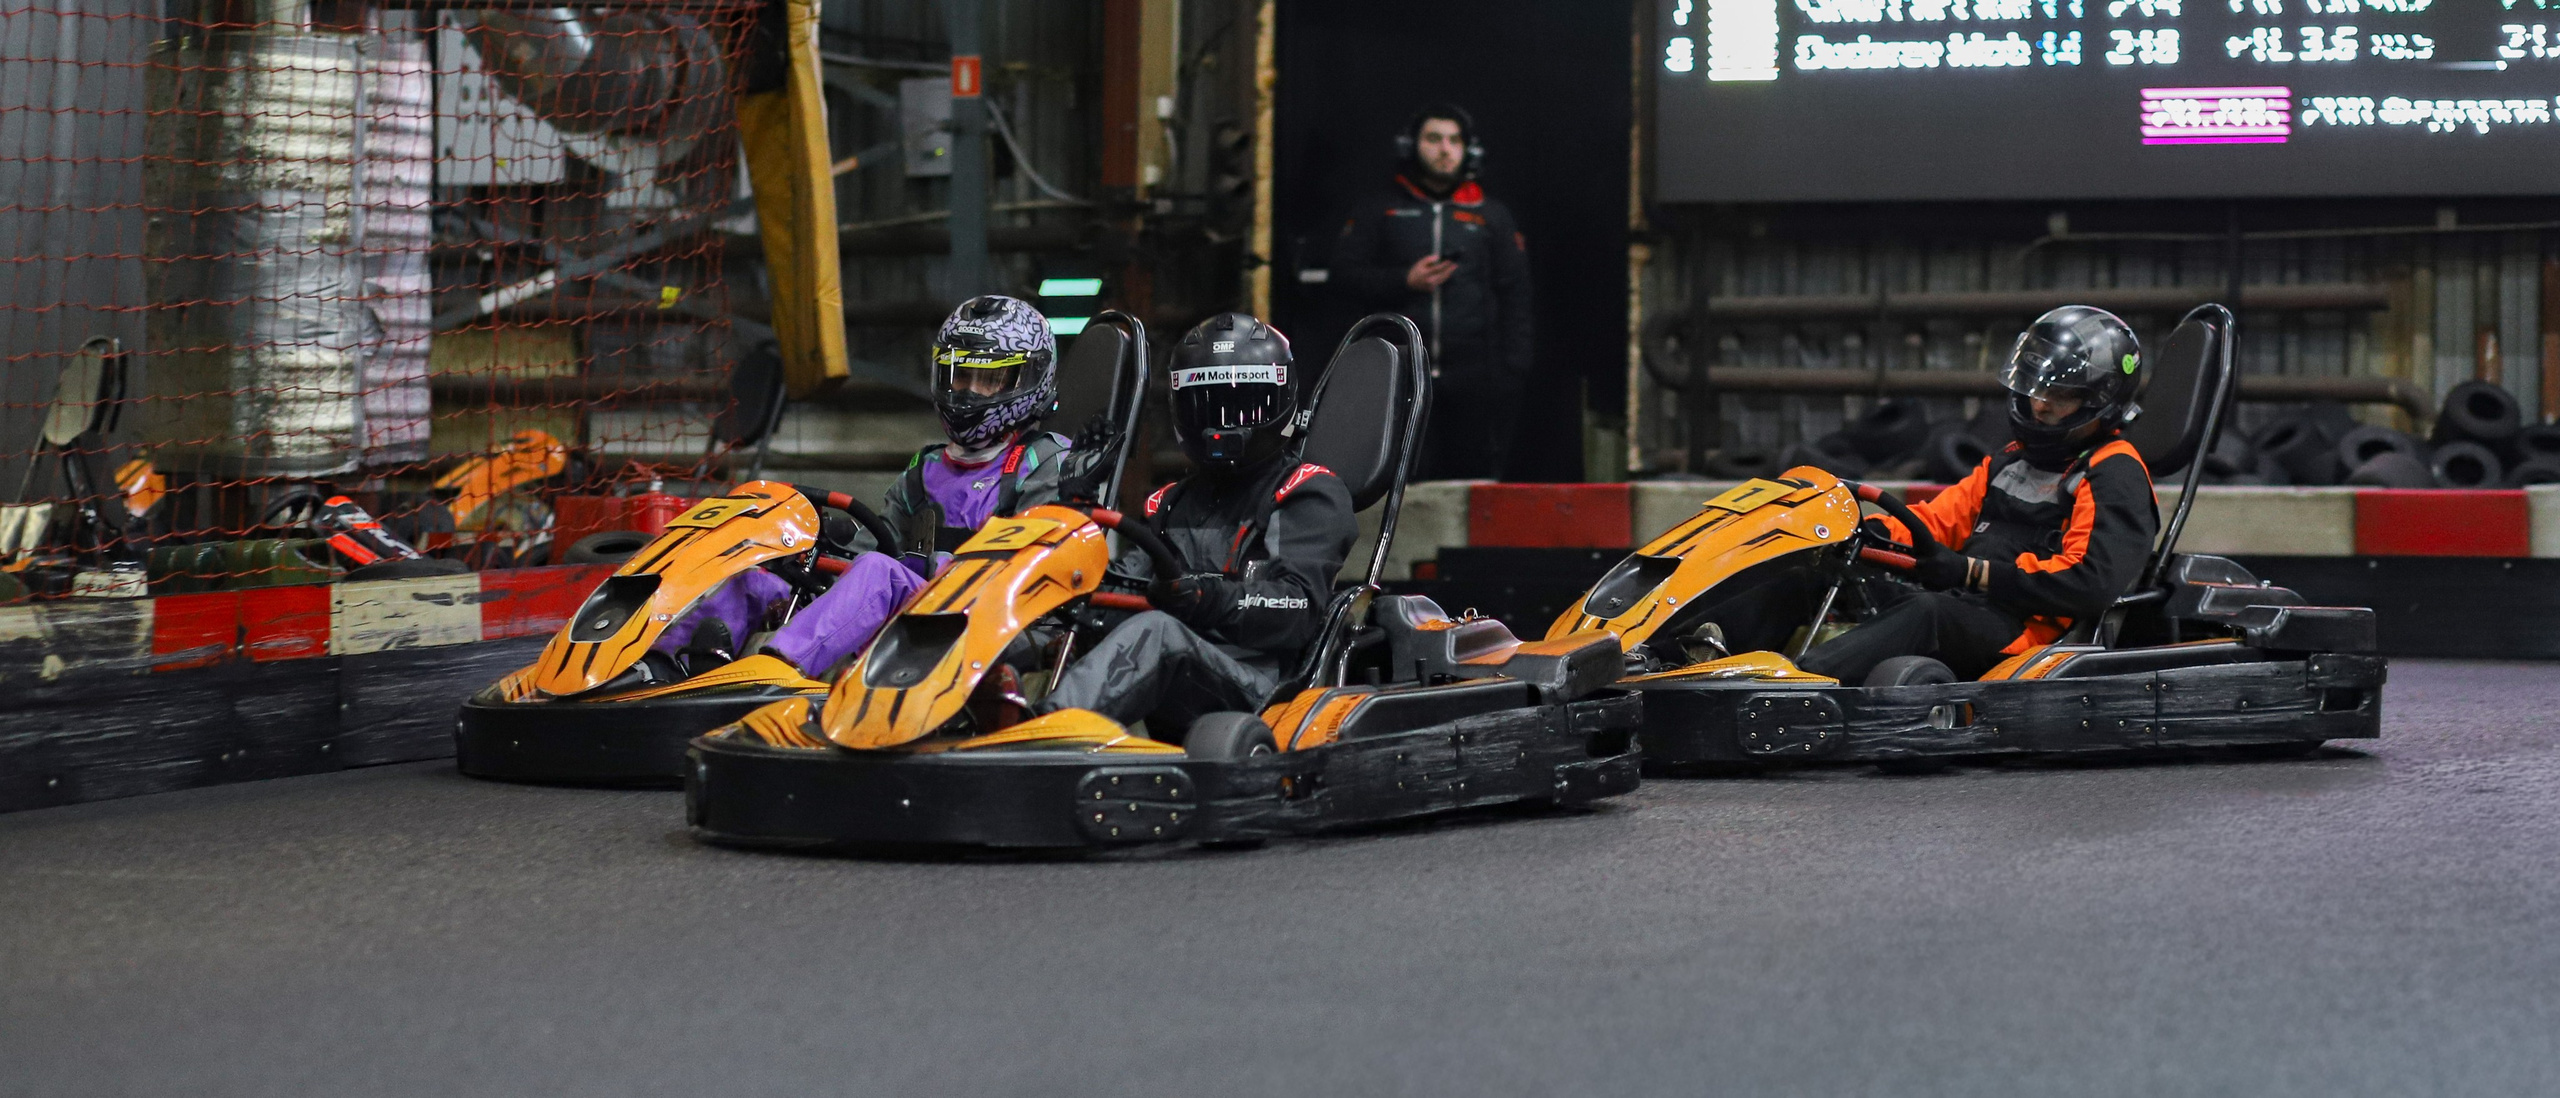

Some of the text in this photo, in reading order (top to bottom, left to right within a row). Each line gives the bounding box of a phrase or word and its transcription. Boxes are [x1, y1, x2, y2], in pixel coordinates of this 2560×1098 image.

[965, 357, 993, 365] FIRST
[1207, 370, 1270, 382] Motorsport
[1731, 487, 1765, 503] 1
[692, 505, 729, 520] 6
[984, 526, 1025, 544] 2
